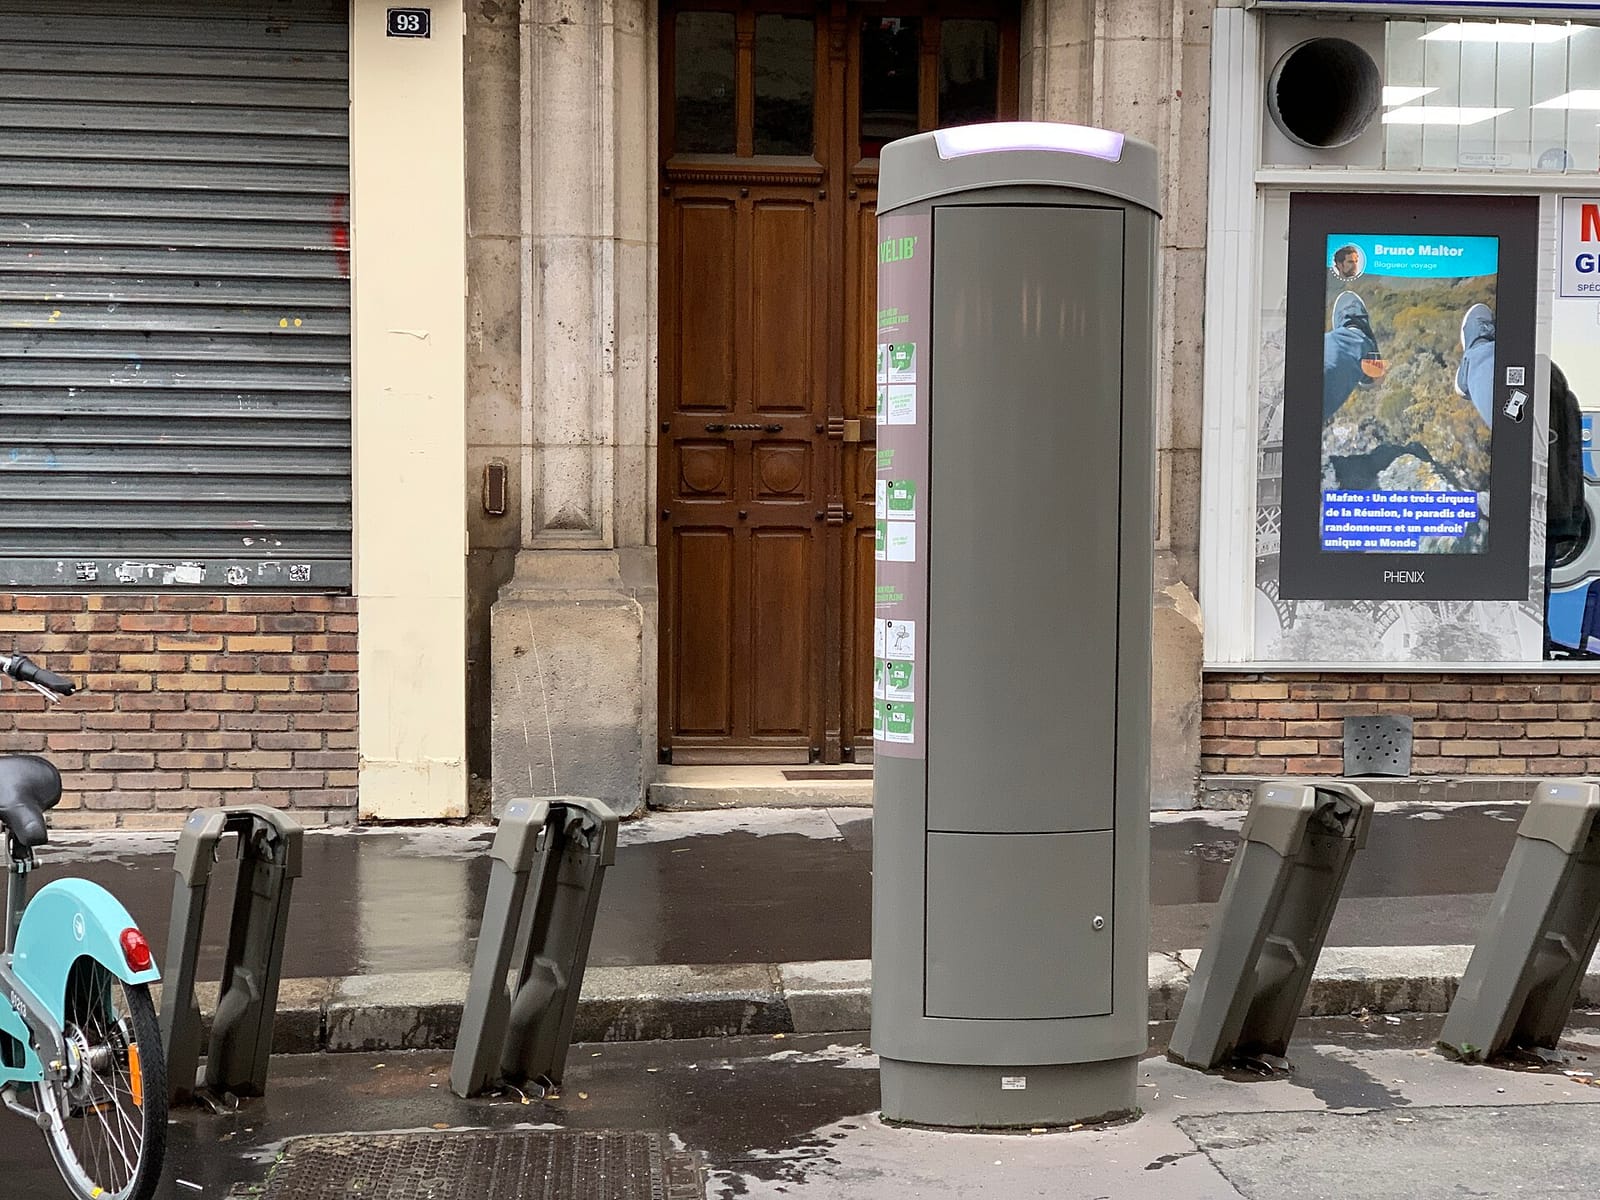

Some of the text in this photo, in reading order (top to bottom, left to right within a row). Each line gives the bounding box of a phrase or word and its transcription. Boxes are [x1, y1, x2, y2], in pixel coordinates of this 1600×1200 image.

[397, 14, 420, 31] 93
[1374, 245, 1464, 256] Bruno Maltor
[1374, 261, 1408, 269] Blogueur
[1326, 494, 1363, 503] Mafate
[1372, 494, 1387, 503] Un
[1389, 494, 1408, 503] des
[1411, 494, 1433, 503] trois
[1436, 495, 1475, 505] cirques
[1326, 508, 1476, 520] de la Réunion, le paradis des
[1325, 523, 1392, 532] randonneurs
[1394, 524, 1405, 532] et
[1423, 523, 1463, 533] endroit
[1325, 537, 1417, 549] unique au Monde
[1383, 571, 1425, 583] PHENIX
